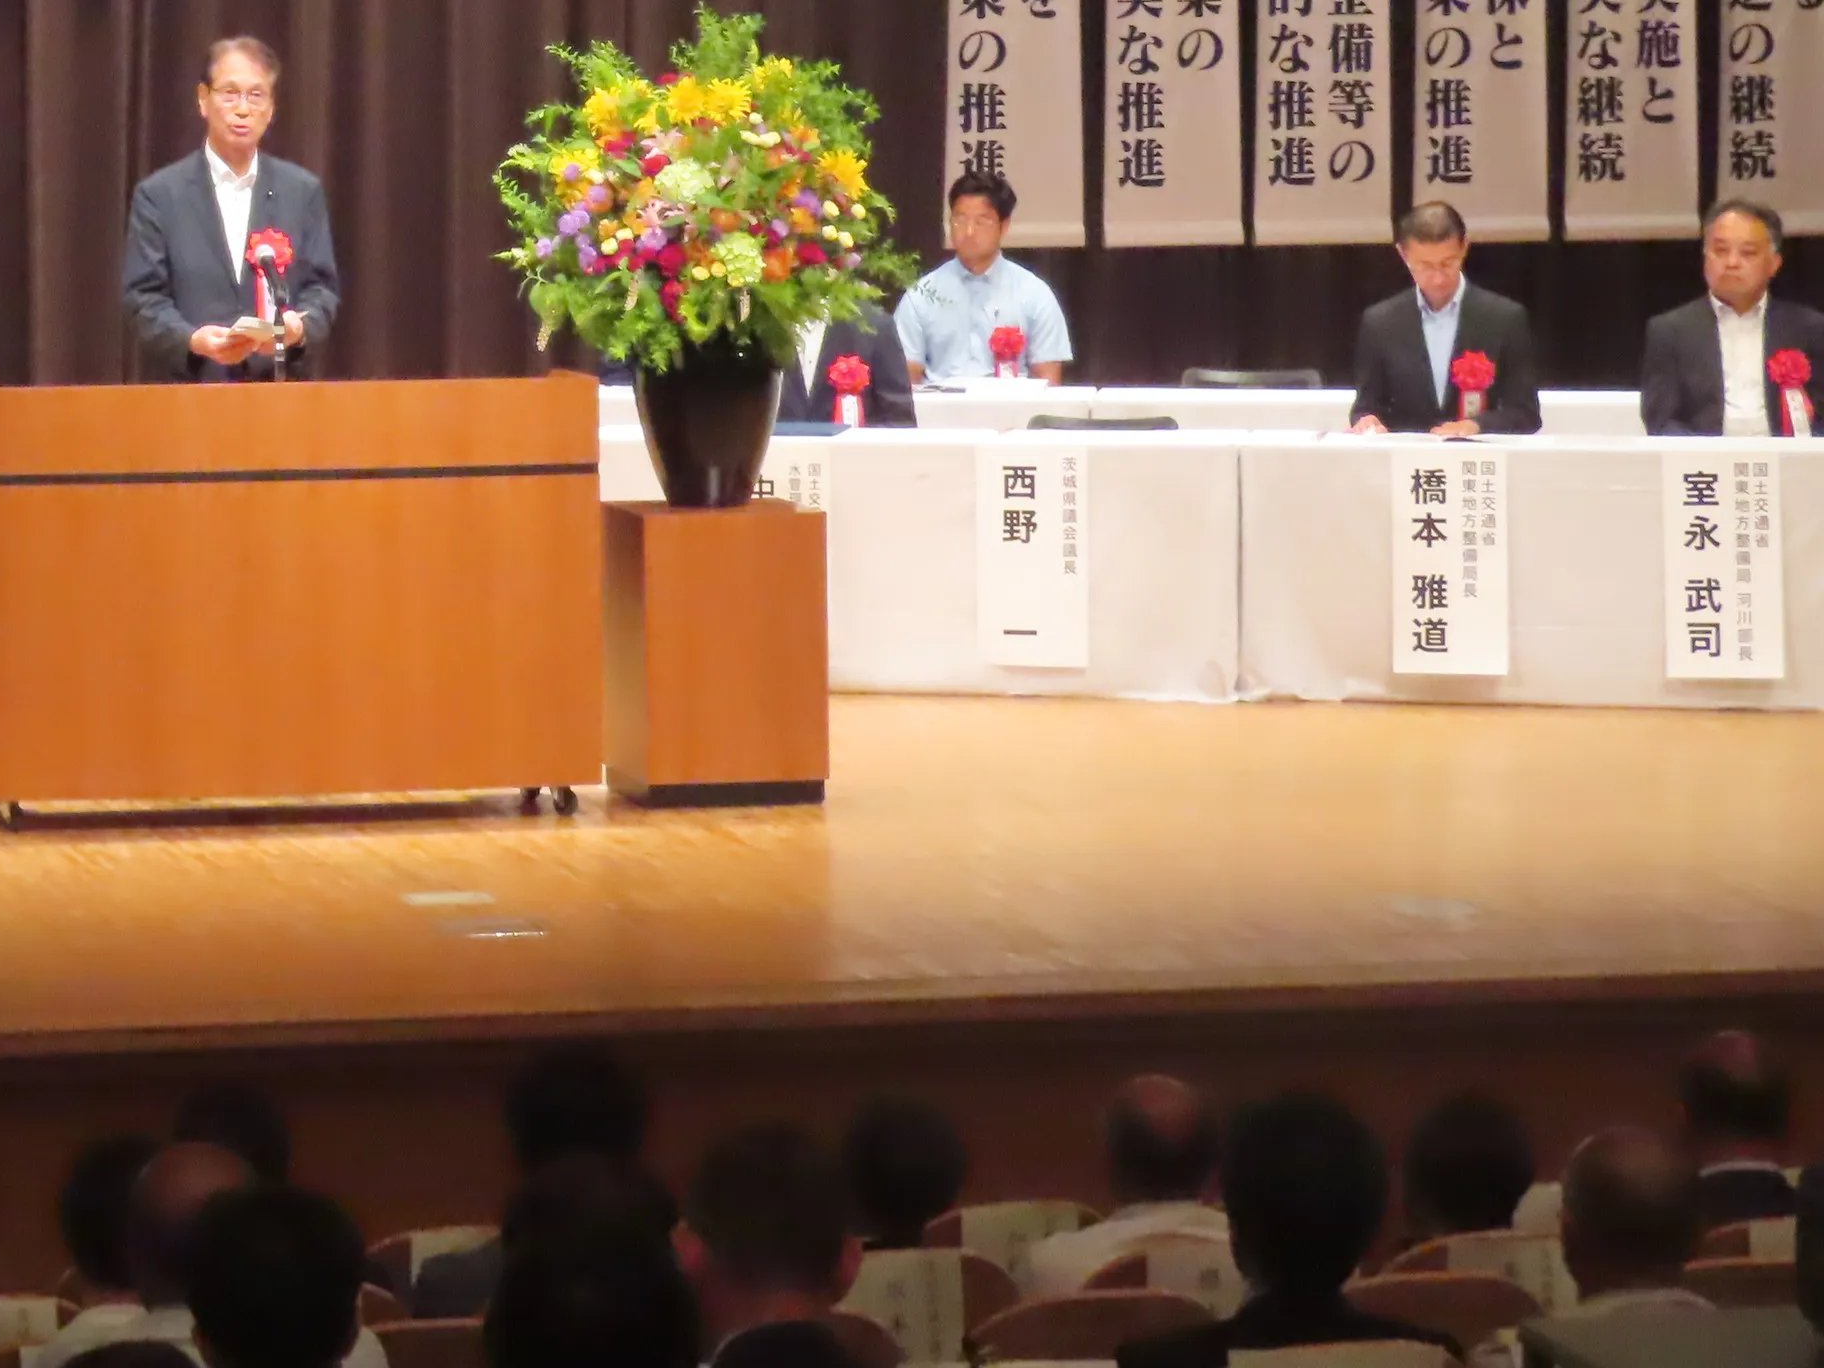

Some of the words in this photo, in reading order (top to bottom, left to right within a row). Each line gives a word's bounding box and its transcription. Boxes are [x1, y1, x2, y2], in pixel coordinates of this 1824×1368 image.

[807, 462, 823, 509] 国土交
[1002, 465, 1038, 544] 西野
[1062, 456, 1078, 575] 茨城県議会議長
[1410, 468, 1448, 549] 橋本
[1480, 460, 1497, 546] 国土交通省
[1682, 470, 1721, 551] 室永
[1733, 461, 1753, 584] 関東地方整備局
[1752, 461, 1770, 548] 国土交通省
[1461, 460, 1478, 598] 関東地方整備局長
[1002, 627, 1039, 638] 一
[1411, 573, 1449, 653] 雅道
[1684, 577, 1723, 658] 武司
